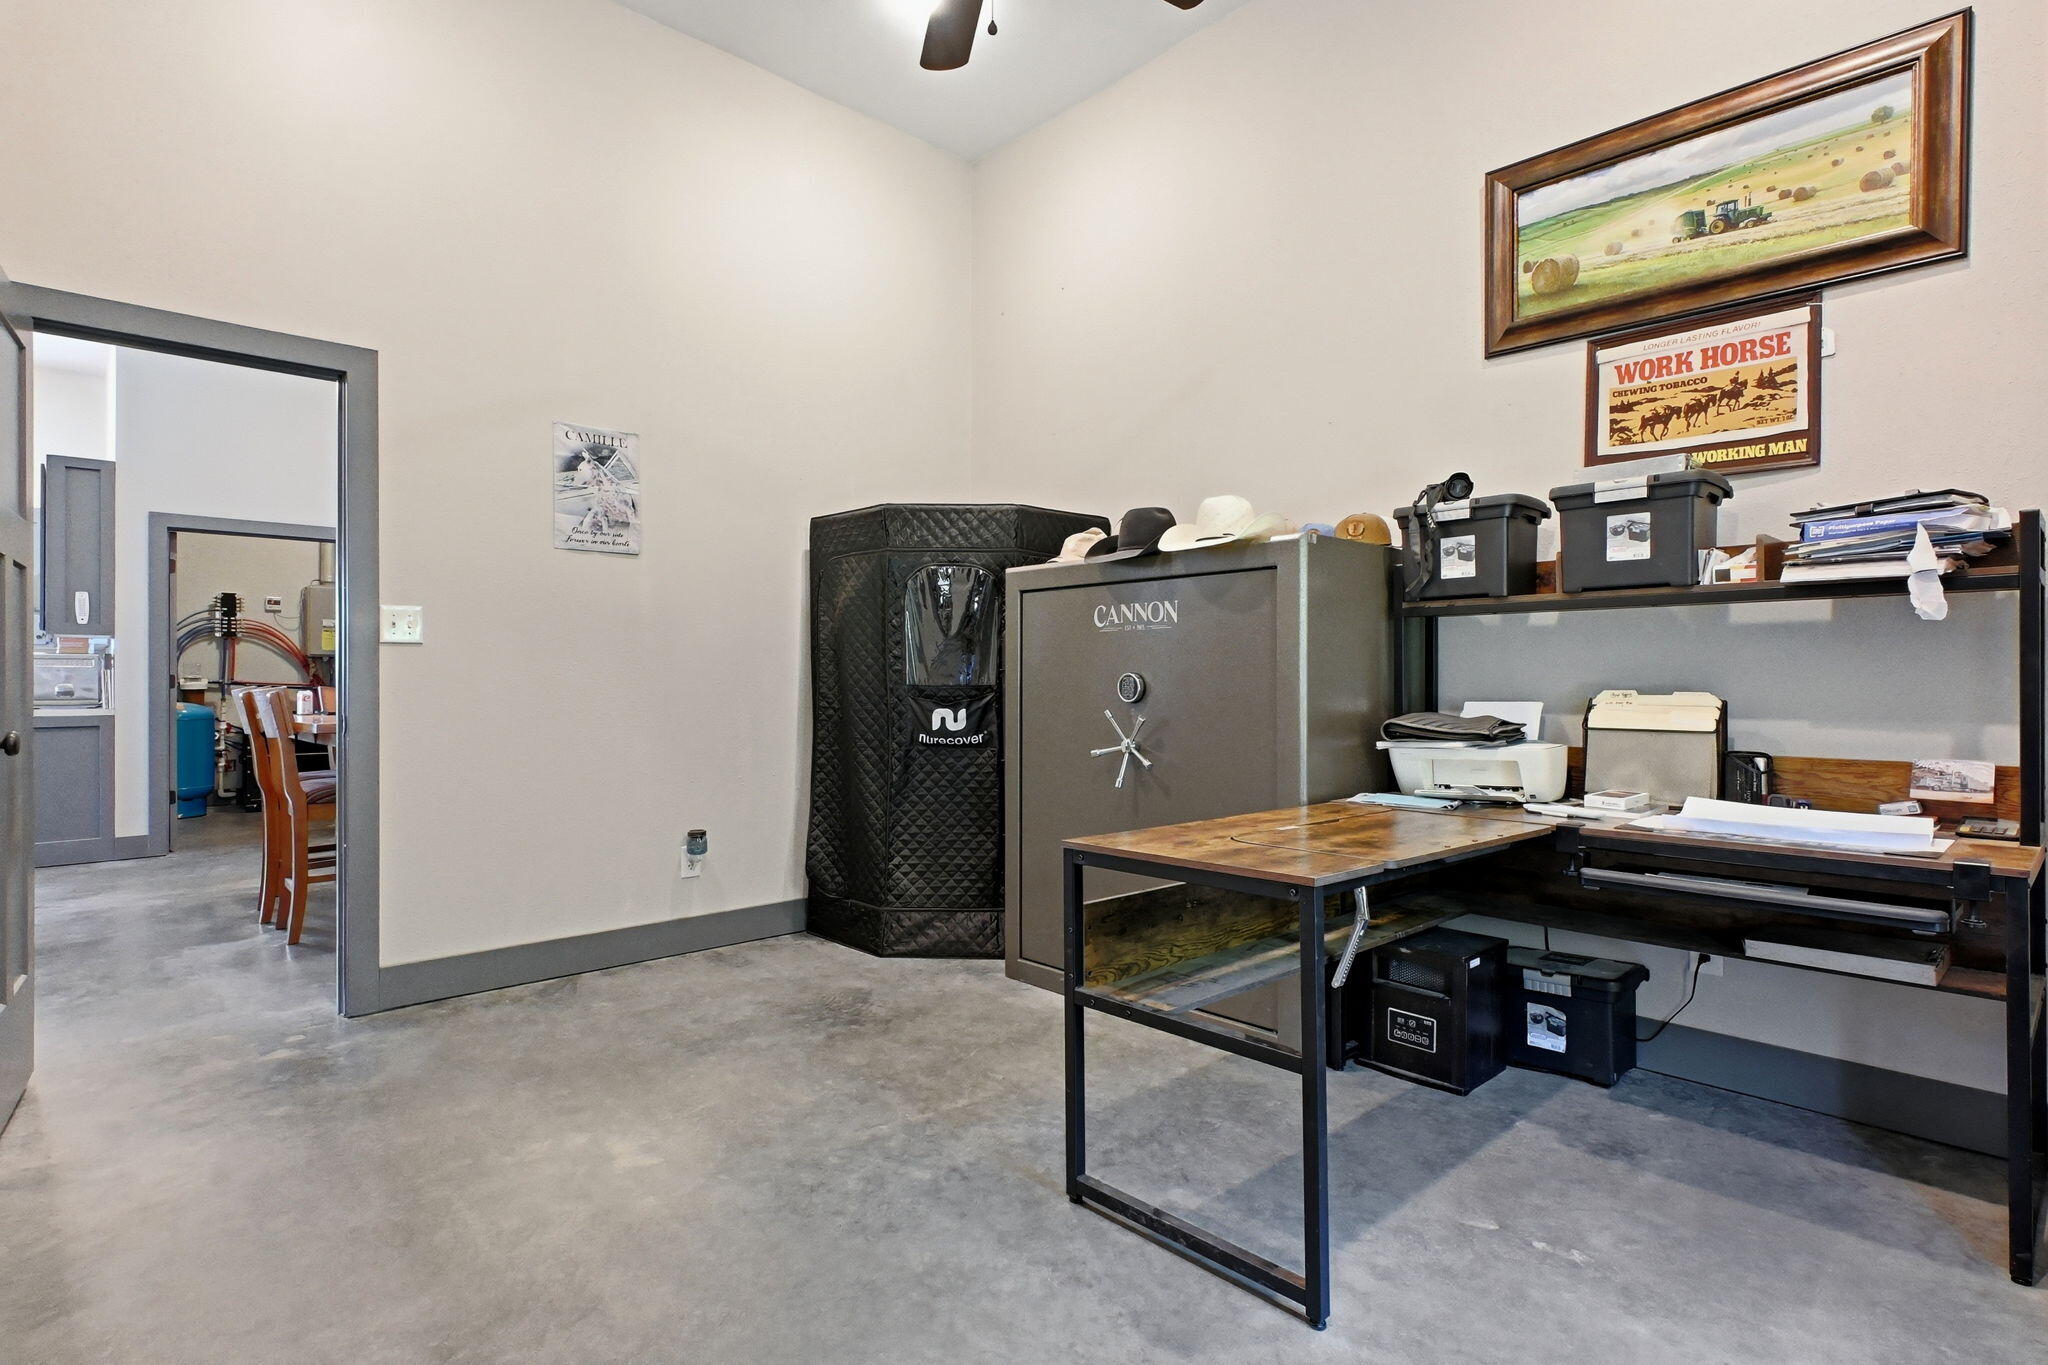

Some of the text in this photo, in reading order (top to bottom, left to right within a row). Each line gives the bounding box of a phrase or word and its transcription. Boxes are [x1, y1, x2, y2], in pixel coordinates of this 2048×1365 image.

[1643, 321, 1761, 351] LONGER LASTING FLAVOR!
[1614, 331, 1792, 385] WORK HORSE
[1612, 376, 1708, 398] CHEWING TOBACCO
[565, 429, 628, 449] CAMILLE
[1692, 438, 1808, 464] WORKING MAN
[1828, 522, 1874, 531] Multipurpose
[1093, 600, 1179, 628] CANNON
